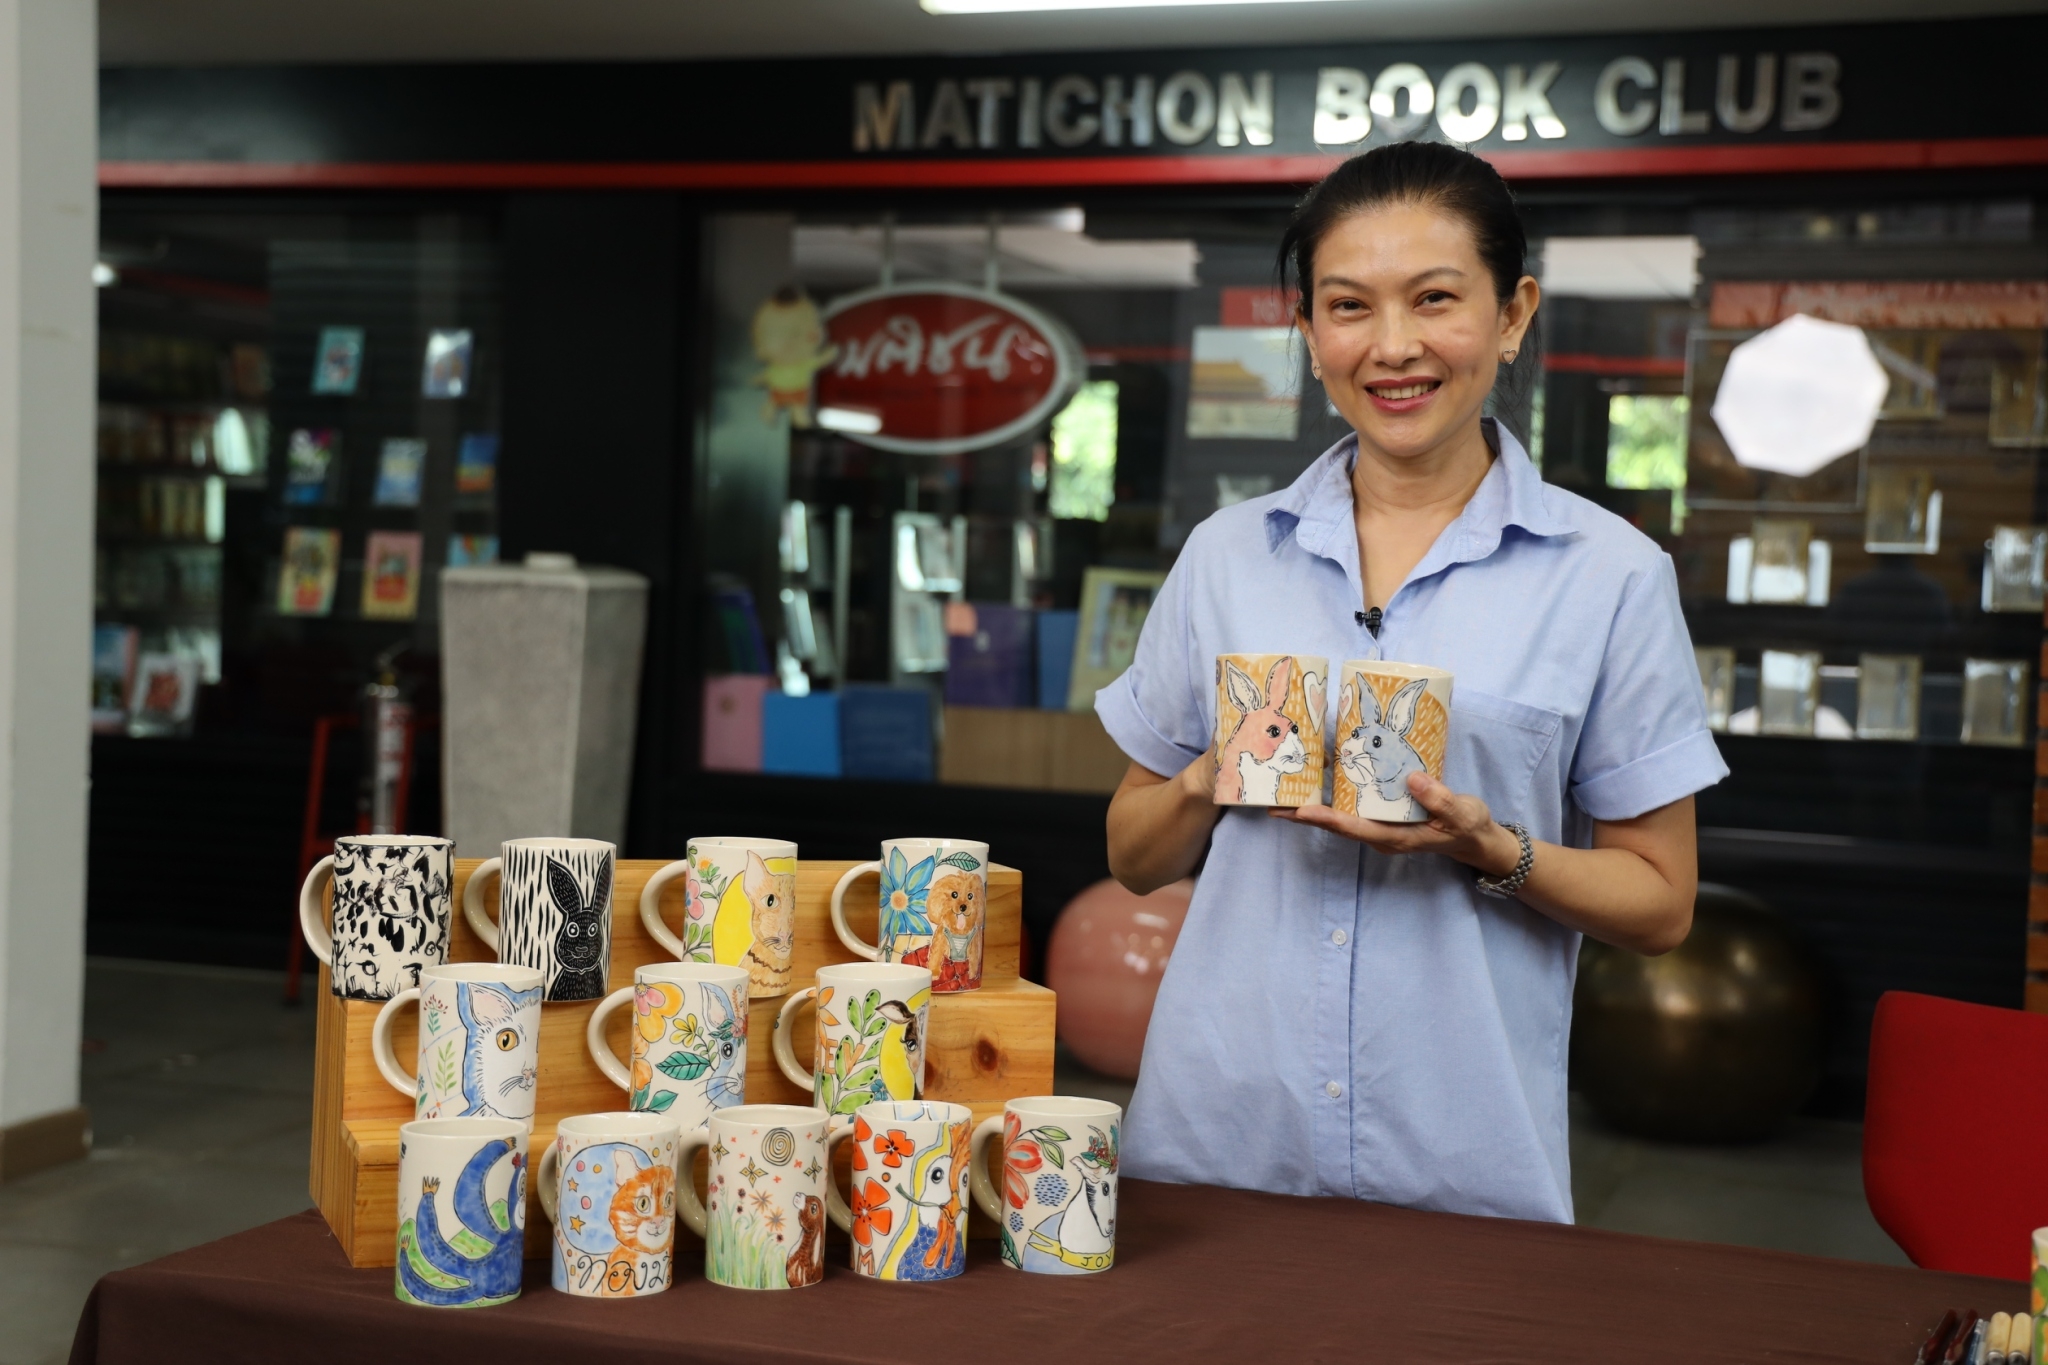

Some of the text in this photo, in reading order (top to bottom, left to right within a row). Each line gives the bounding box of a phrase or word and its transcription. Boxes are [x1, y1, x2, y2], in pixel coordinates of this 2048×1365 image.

[853, 53, 1842, 151] MATICHON BOOK CLUB
